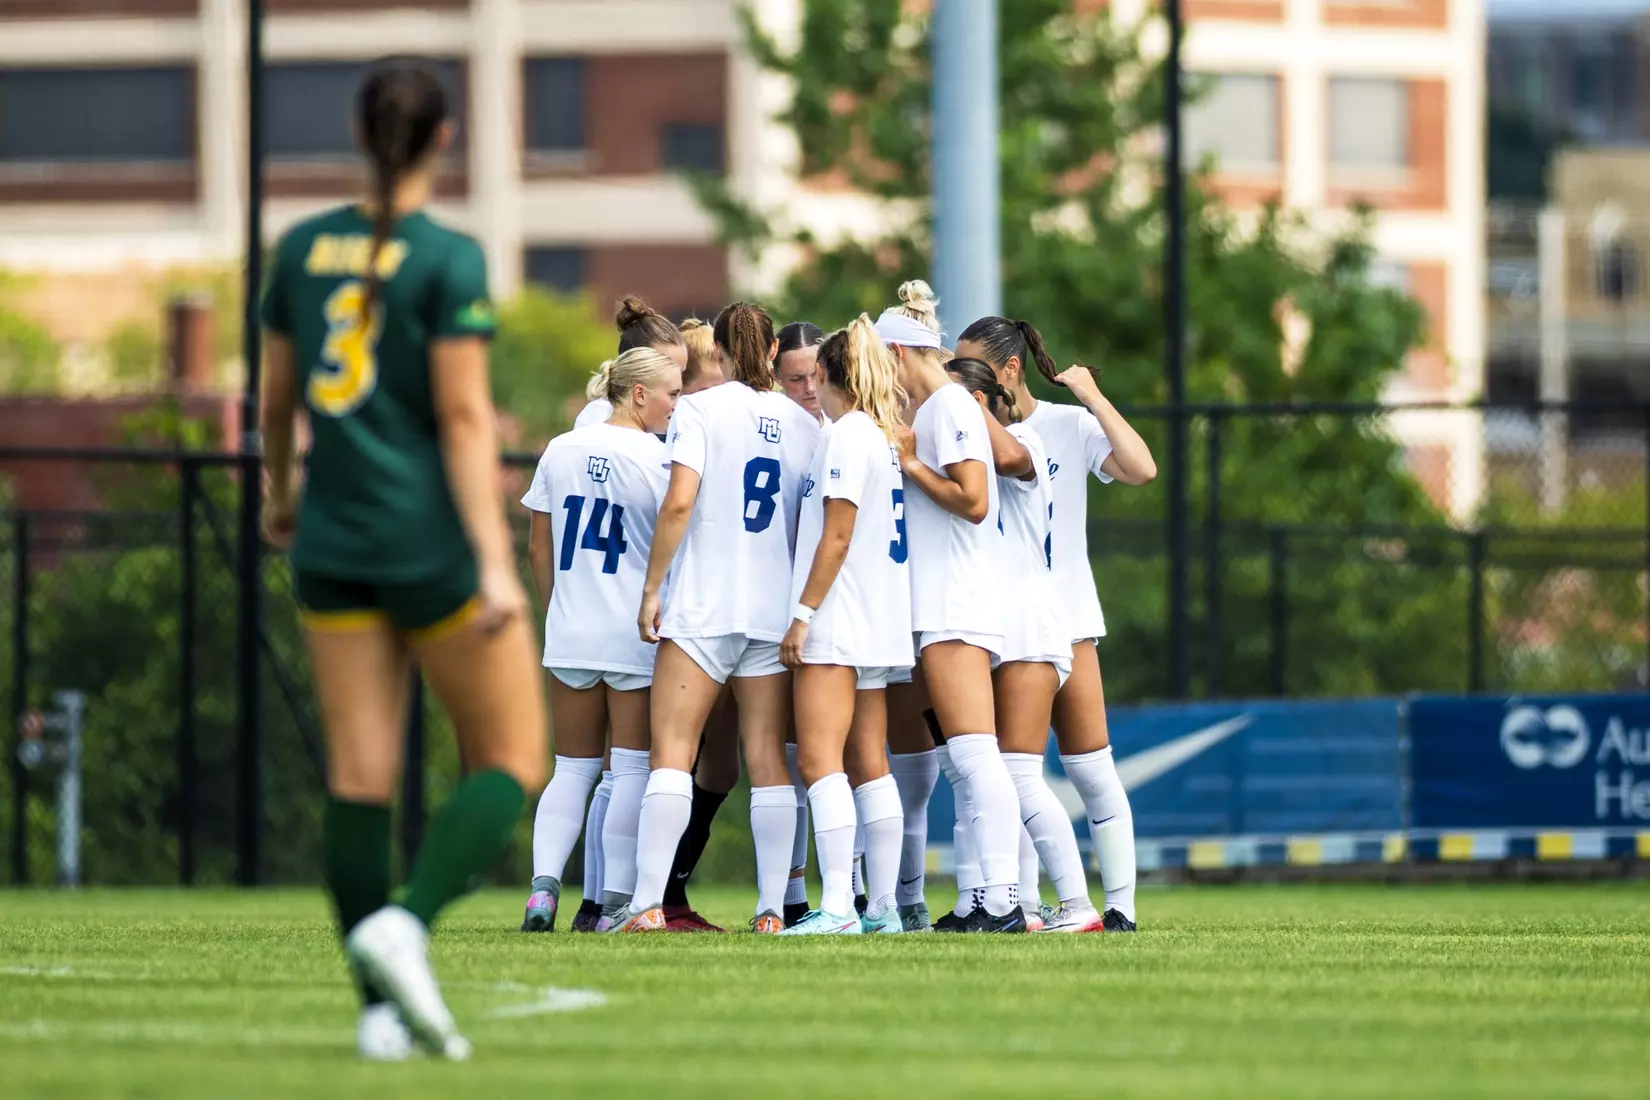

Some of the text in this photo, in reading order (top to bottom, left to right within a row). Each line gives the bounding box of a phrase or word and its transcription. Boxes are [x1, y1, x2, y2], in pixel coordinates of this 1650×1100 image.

[306, 279, 385, 418] 3
[759, 416, 782, 444] MU
[587, 456, 610, 483] MU
[743, 456, 781, 533] 8
[559, 494, 628, 575] 14
[888, 488, 909, 564] 3
